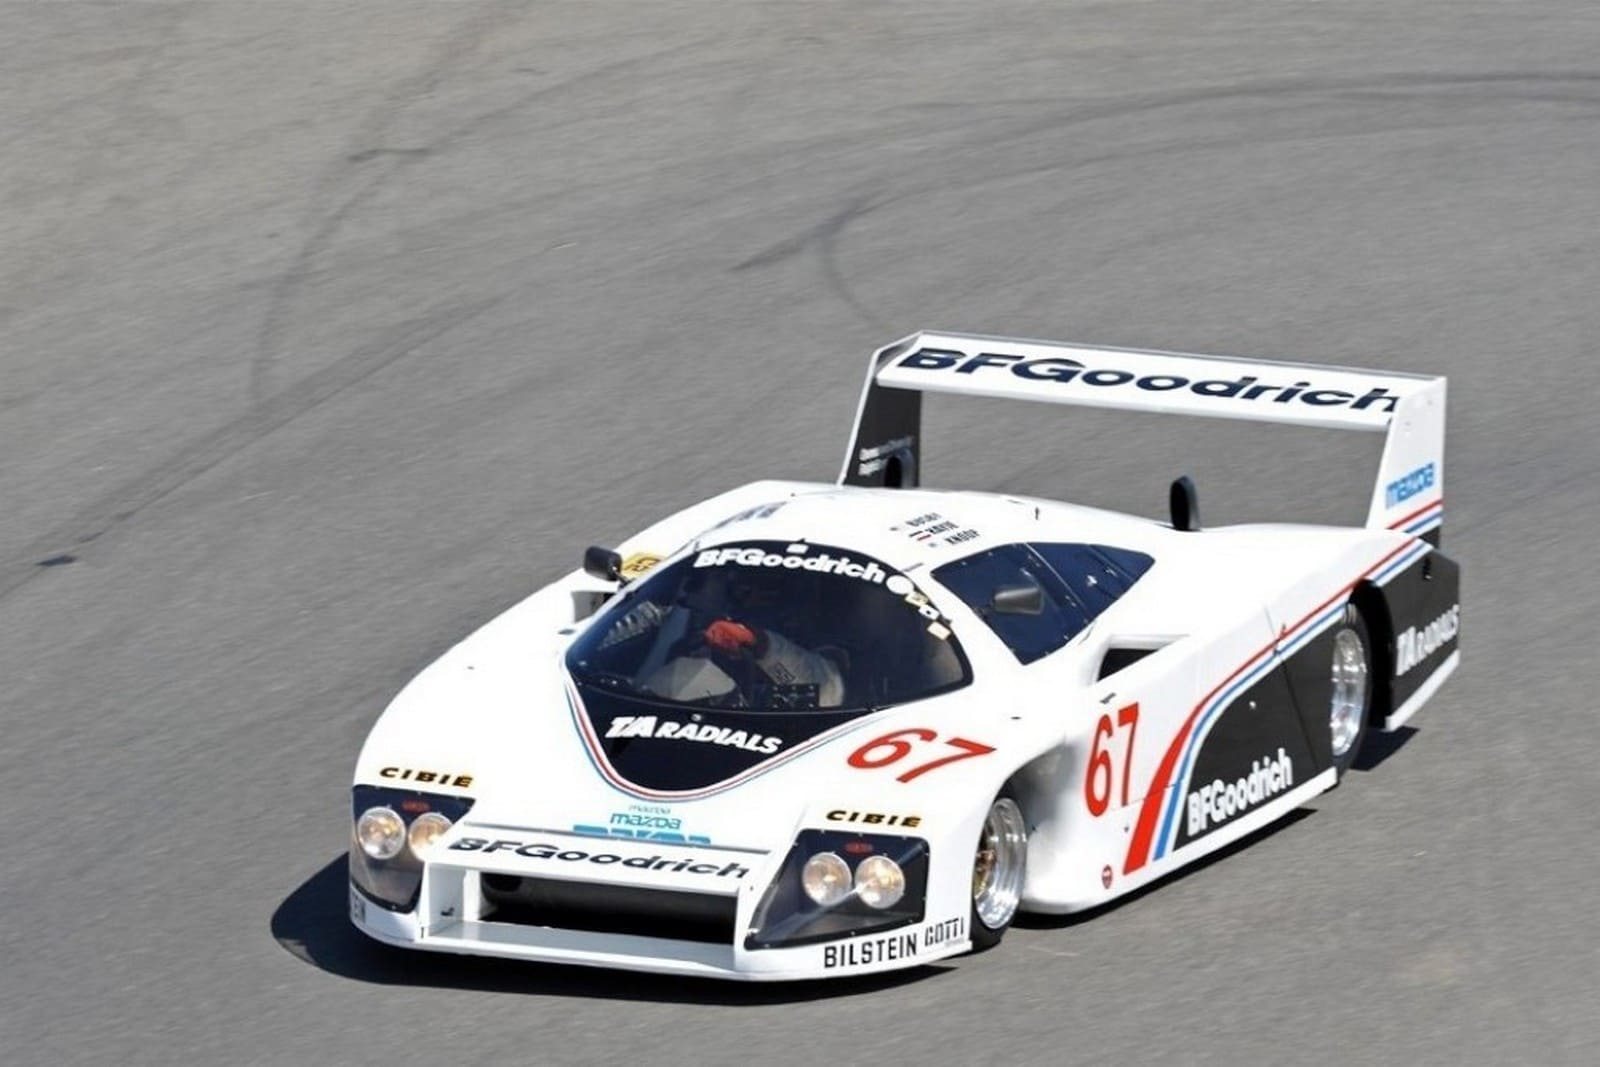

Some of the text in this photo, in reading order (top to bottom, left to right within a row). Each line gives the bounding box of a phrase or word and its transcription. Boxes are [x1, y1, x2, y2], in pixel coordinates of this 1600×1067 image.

[897, 348, 1400, 413] BFGoodrich
[693, 548, 887, 584] BFGoodrich
[655, 721, 783, 755] RADIALS
[847, 728, 996, 784] 67
[1085, 702, 1139, 817] 67
[1187, 747, 1293, 837] BFGoodrich
[610, 812, 682, 830] mazda
[448, 837, 750, 879] BFGoodrich
[824, 917, 964, 968] BILSTEIN GOTTI
